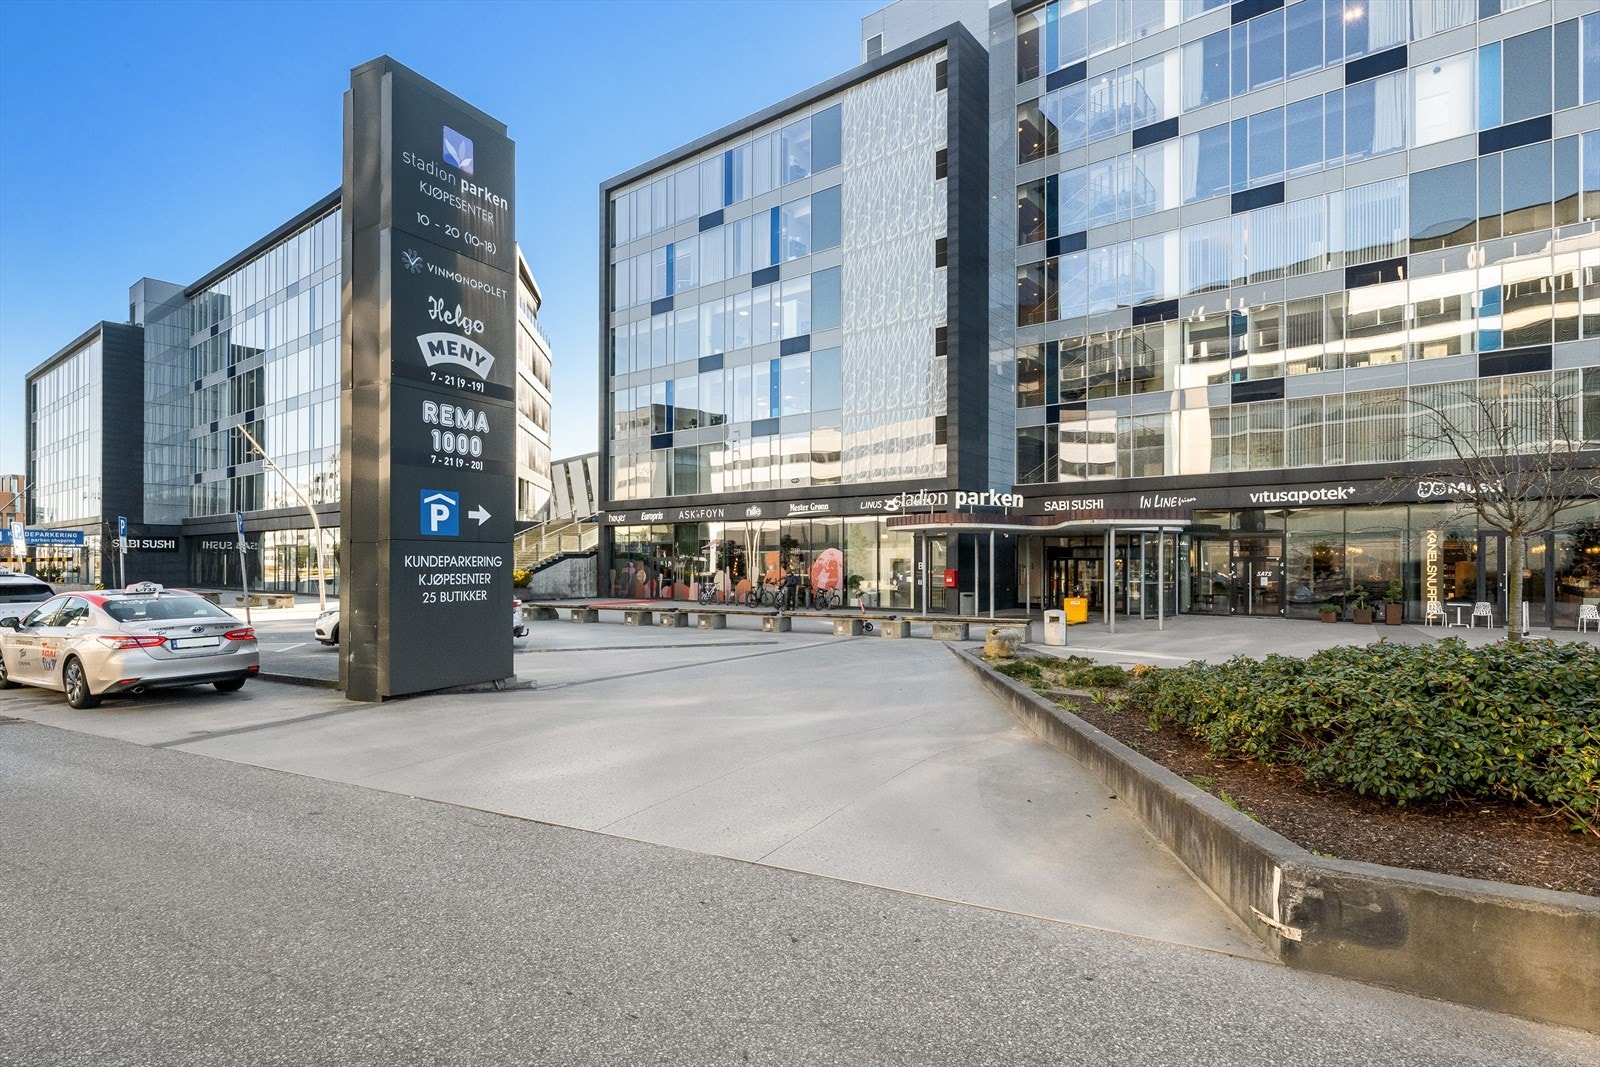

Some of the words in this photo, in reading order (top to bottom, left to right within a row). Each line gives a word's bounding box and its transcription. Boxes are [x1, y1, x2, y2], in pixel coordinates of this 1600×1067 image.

[402, 151, 456, 186] stadion
[461, 179, 508, 211] parken
[420, 181, 495, 224] KJØPESENTER
[416, 212, 430, 226] 10
[445, 224, 460, 239] 20
[464, 231, 497, 255] (10-18)
[427, 263, 508, 300] VINMONOPOLET
[427, 340, 487, 368] MENY
[430, 371, 438, 382] 7
[444, 375, 455, 386] 21
[422, 400, 490, 434] REMA
[430, 428, 483, 458] 1000
[430, 455, 437, 464] 7
[444, 457, 454, 466] 21
[860, 500, 883, 510] LINUS
[955, 488, 1024, 509] parken
[1044, 500, 1070, 512] SABI
[1071, 498, 1104, 511] SUSHI
[1140, 495, 1152, 509] IN
[1154, 494, 1178, 508] LINE
[789, 503, 809, 512] Mester
[430, 504, 450, 532] P
[640, 511, 664, 523] Europris
[120, 519, 126, 535] P
[112, 539, 140, 549] SBI
[142, 539, 175, 549] SUSHI
[404, 555, 503, 568] KUNDEPARKERING
[418, 573, 492, 586] KJØPESENTER
[422, 591, 437, 604] 25
[440, 590, 488, 603] BUTIKKER
